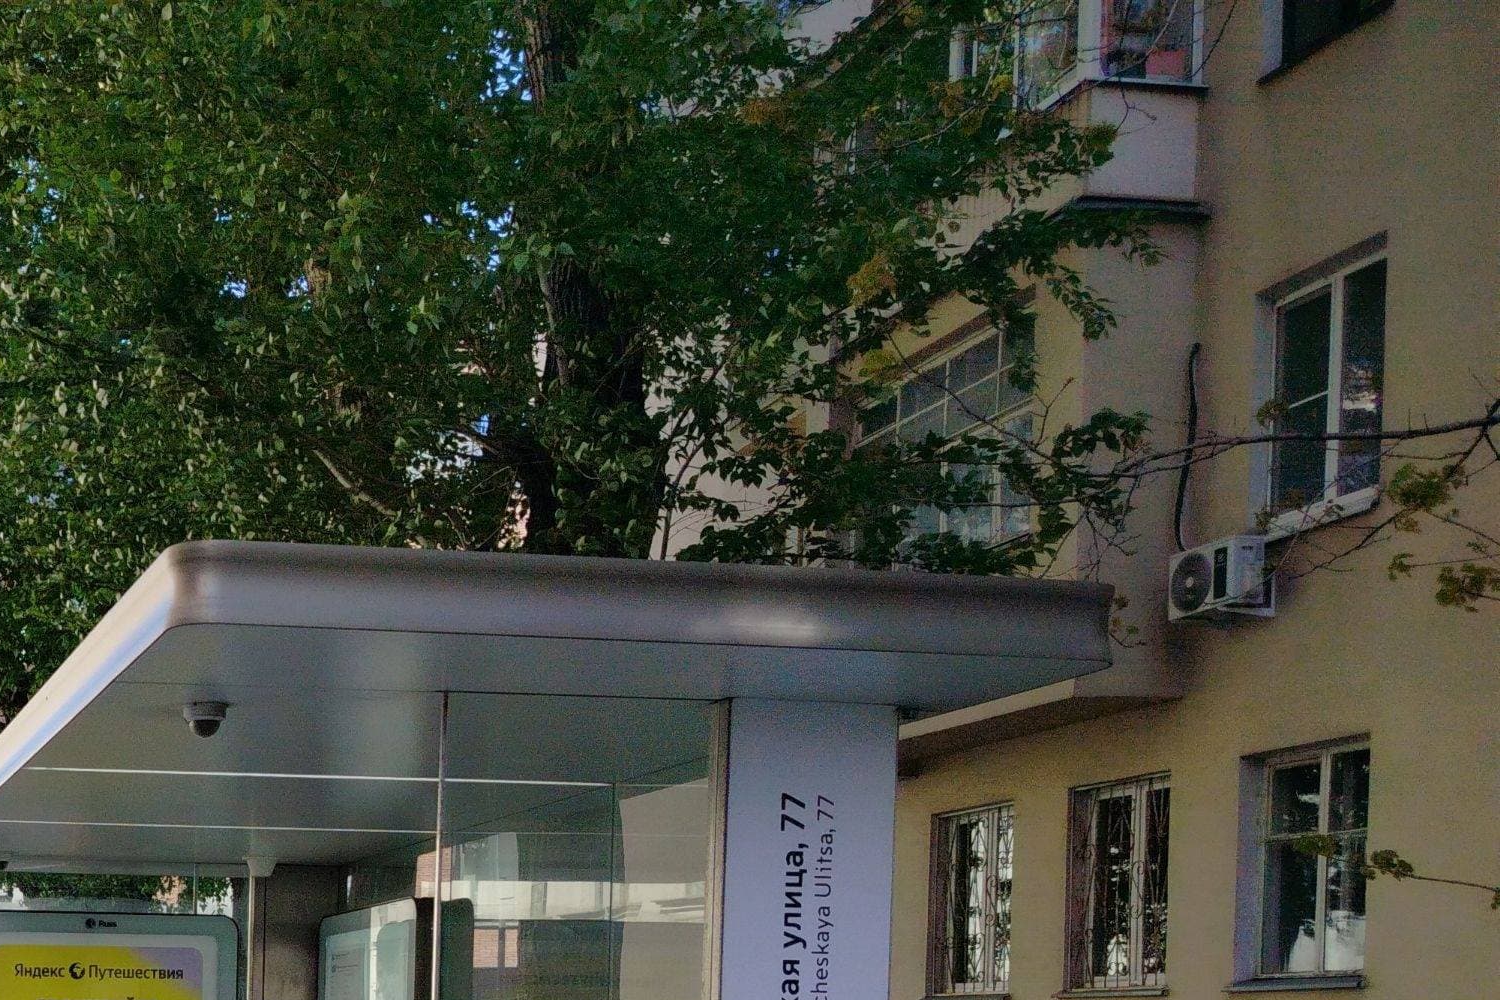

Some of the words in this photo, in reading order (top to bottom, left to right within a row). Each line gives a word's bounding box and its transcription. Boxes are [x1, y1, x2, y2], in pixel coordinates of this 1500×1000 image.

[781, 793, 806, 831] 77
[817, 795, 835, 821] 77
[814, 829, 836, 897] Ulitsa,
[783, 843, 809, 949] улица,
[14, 963, 66, 979] Яндекс
[88, 964, 184, 981] Путешествия
